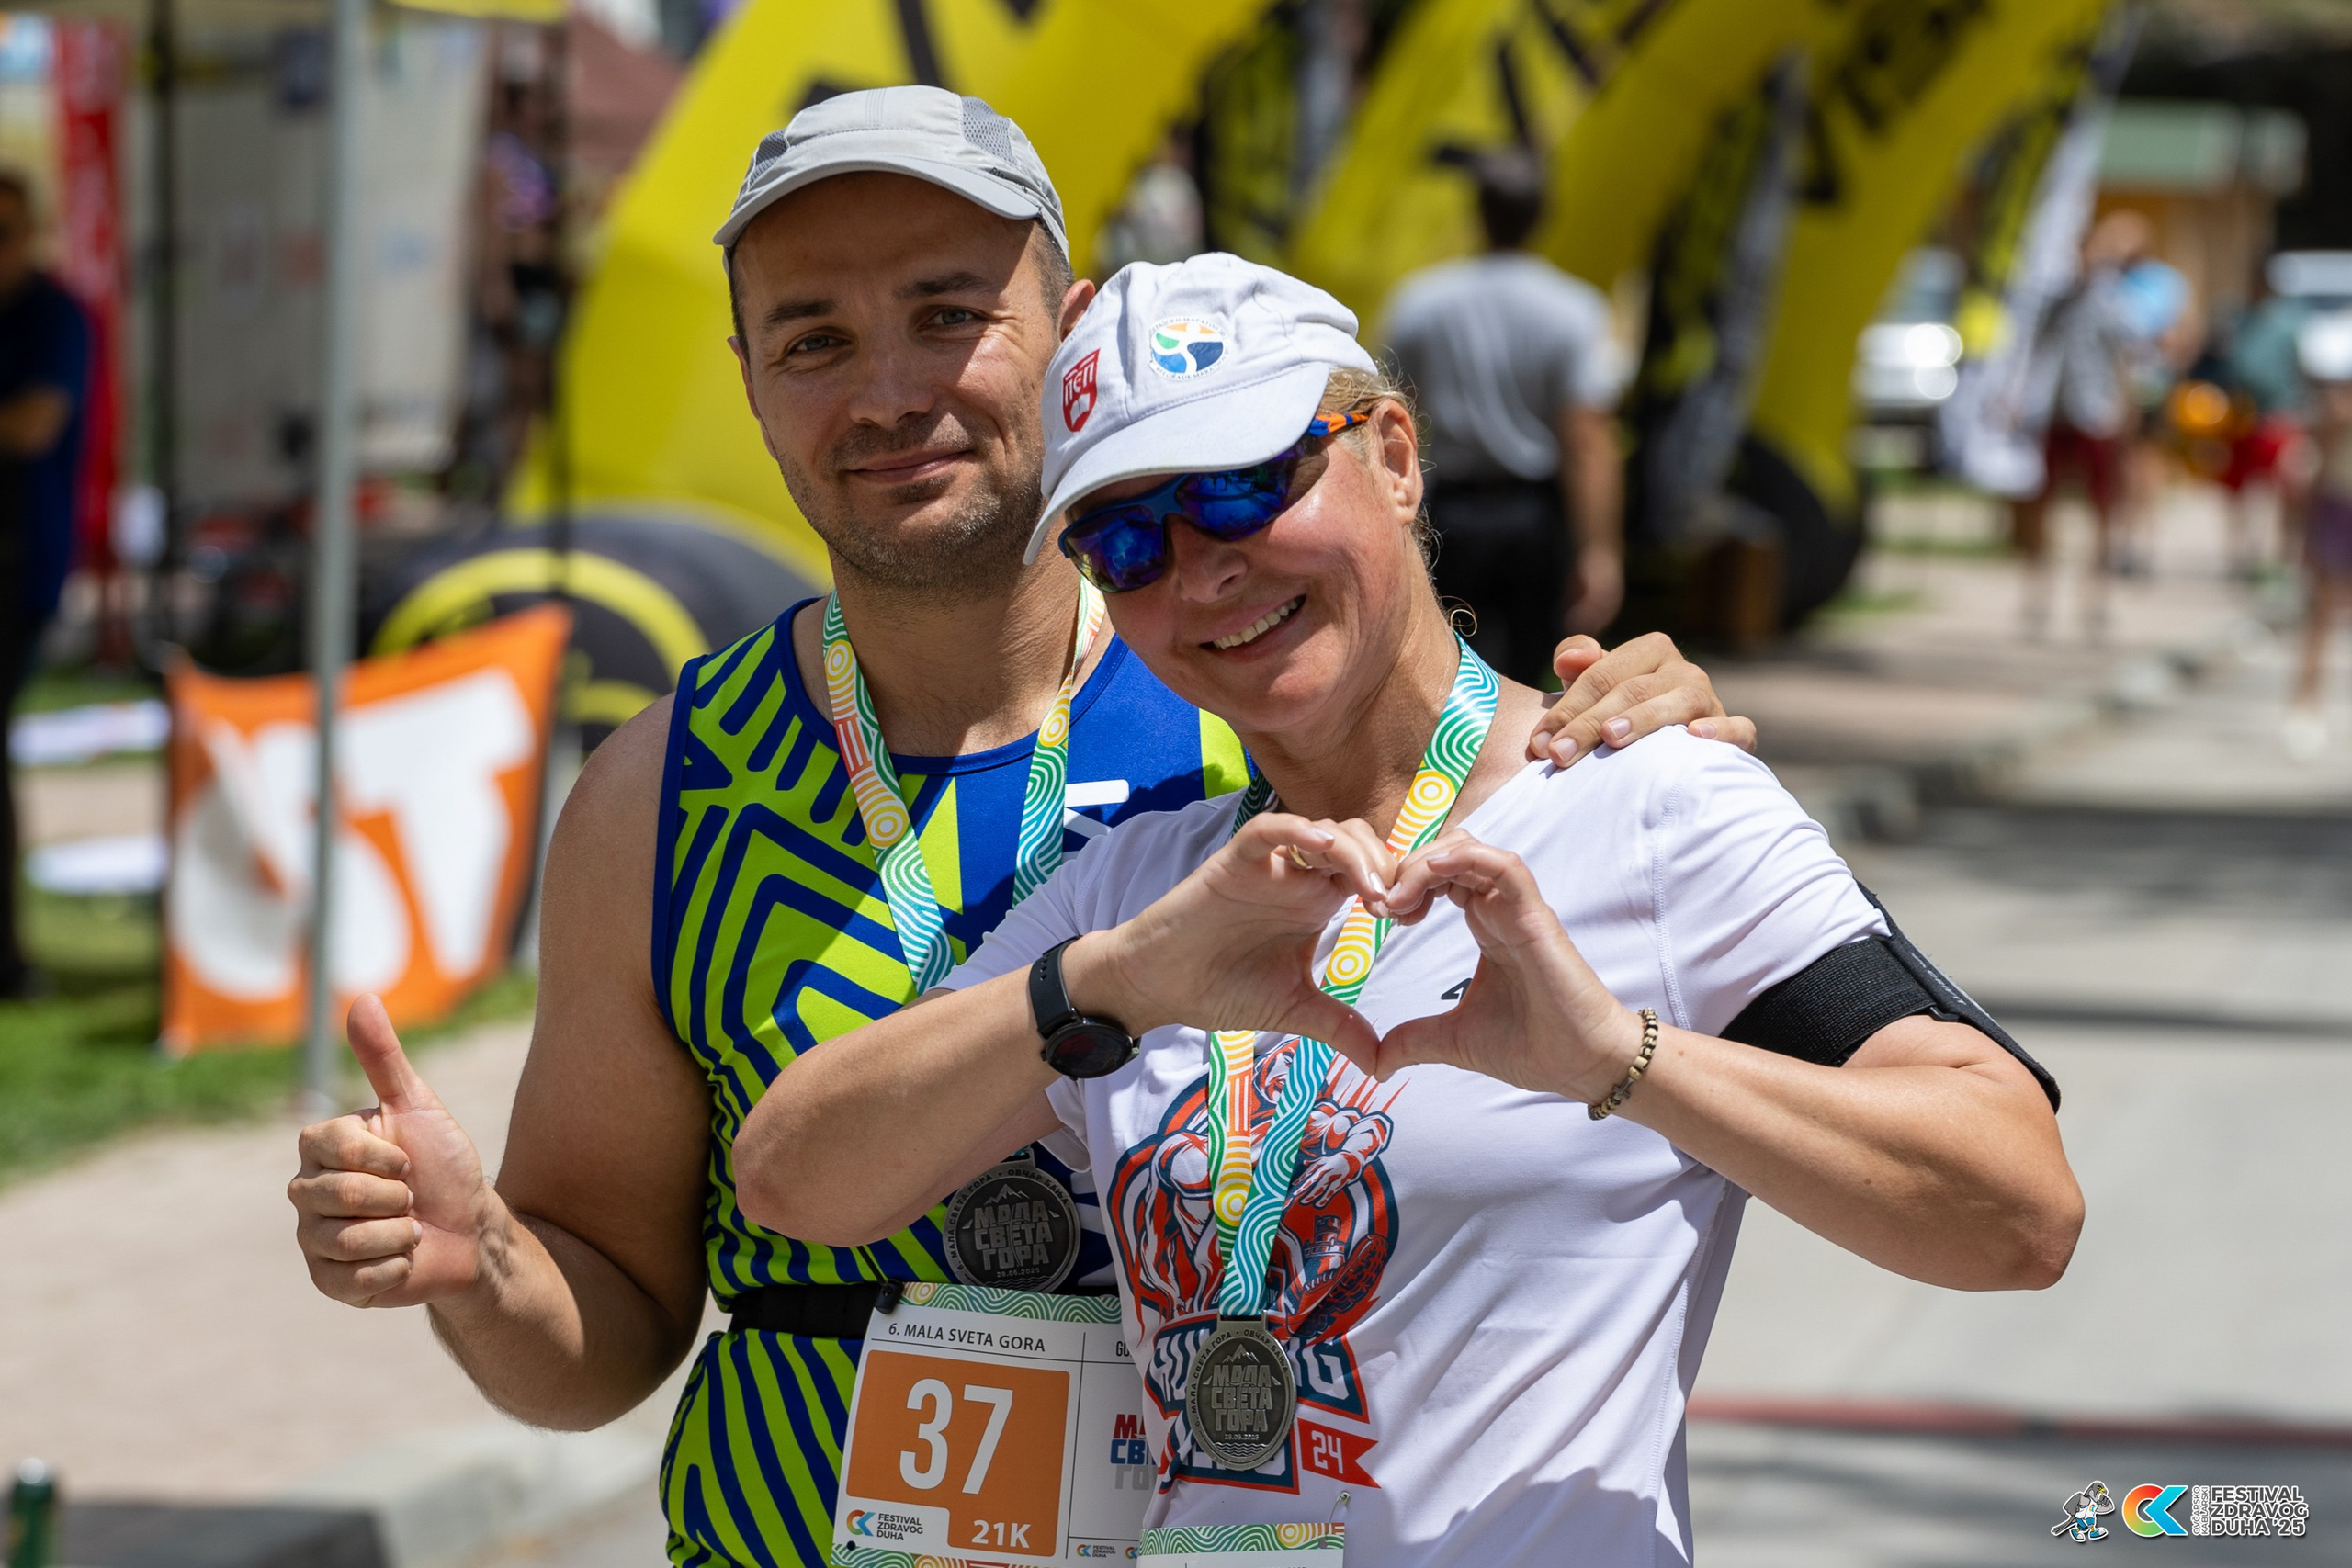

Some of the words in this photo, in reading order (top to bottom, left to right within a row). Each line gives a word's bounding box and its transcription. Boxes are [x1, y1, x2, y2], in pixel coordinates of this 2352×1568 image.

[967, 1174, 993, 1192] ГОРА
[1008, 1168, 1043, 1183] ОВЧАР
[1045, 1179, 1070, 1205] БАЊА
[949, 1193, 968, 1224] СВЕТА
[974, 1200, 1049, 1228] МАЛА
[947, 1229, 958, 1258] МАЛА
[974, 1221, 1053, 1250] СВЕТА
[982, 1243, 1050, 1270] ГОРА
[888, 1323, 900, 1336] 6.
[904, 1324, 944, 1340] MALA
[948, 1328, 993, 1347] SVETA
[999, 1335, 1046, 1352] GORA
[1194, 1348, 1212, 1379] СВЕТА
[1211, 1332, 1232, 1348] ГОРА
[1243, 1328, 1271, 1345] ОВЧАР
[1213, 1364, 1272, 1387] МАЛА
[1211, 1387, 1273, 1410] СВЕТА
[1215, 1409, 1269, 1432] ГОРА
[899, 1378, 1013, 1495] 37
[1311, 1430, 1343, 1474] 24
[877, 1521, 923, 1535] ZDRAVOG
[878, 1513, 922, 1526] FESTIVAL
[876, 1529, 904, 1540] DUHA
[971, 1519, 1032, 1549] 21K
